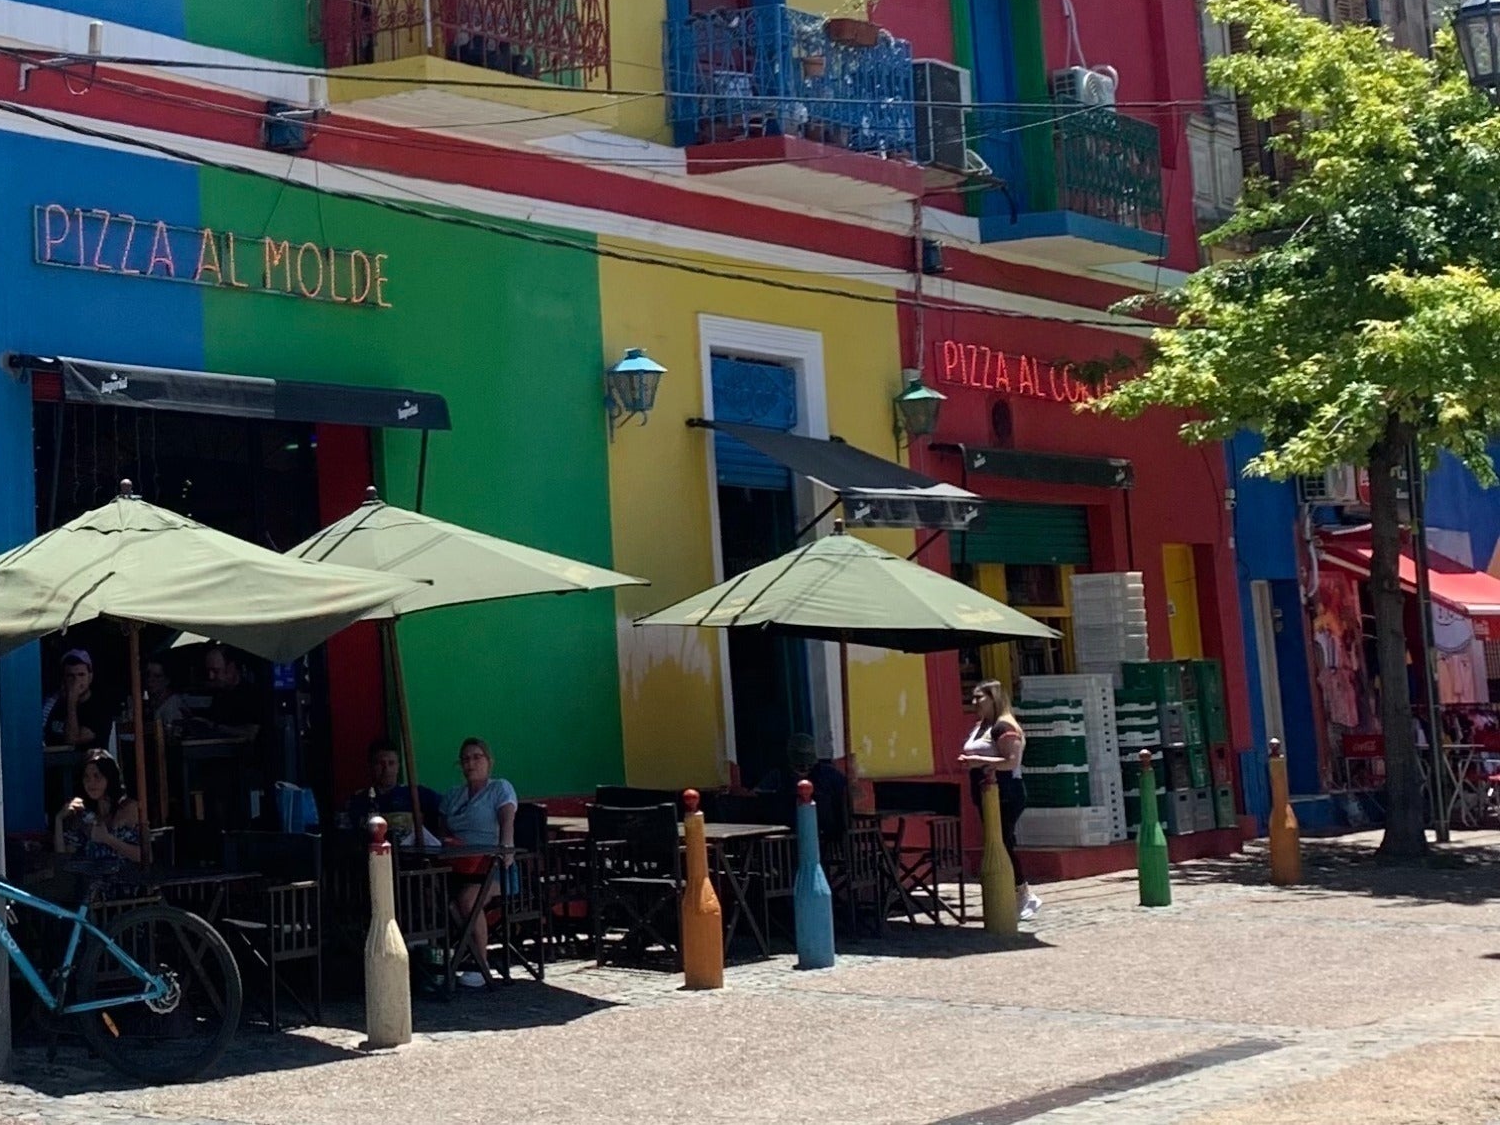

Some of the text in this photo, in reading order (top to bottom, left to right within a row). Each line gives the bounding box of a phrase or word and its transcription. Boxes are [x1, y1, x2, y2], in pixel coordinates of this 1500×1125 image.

[45, 204, 393, 308] PIZZA AL MOLDE
[943, 340, 1012, 393] PIZZA
[1019, 354, 1046, 397] AL
